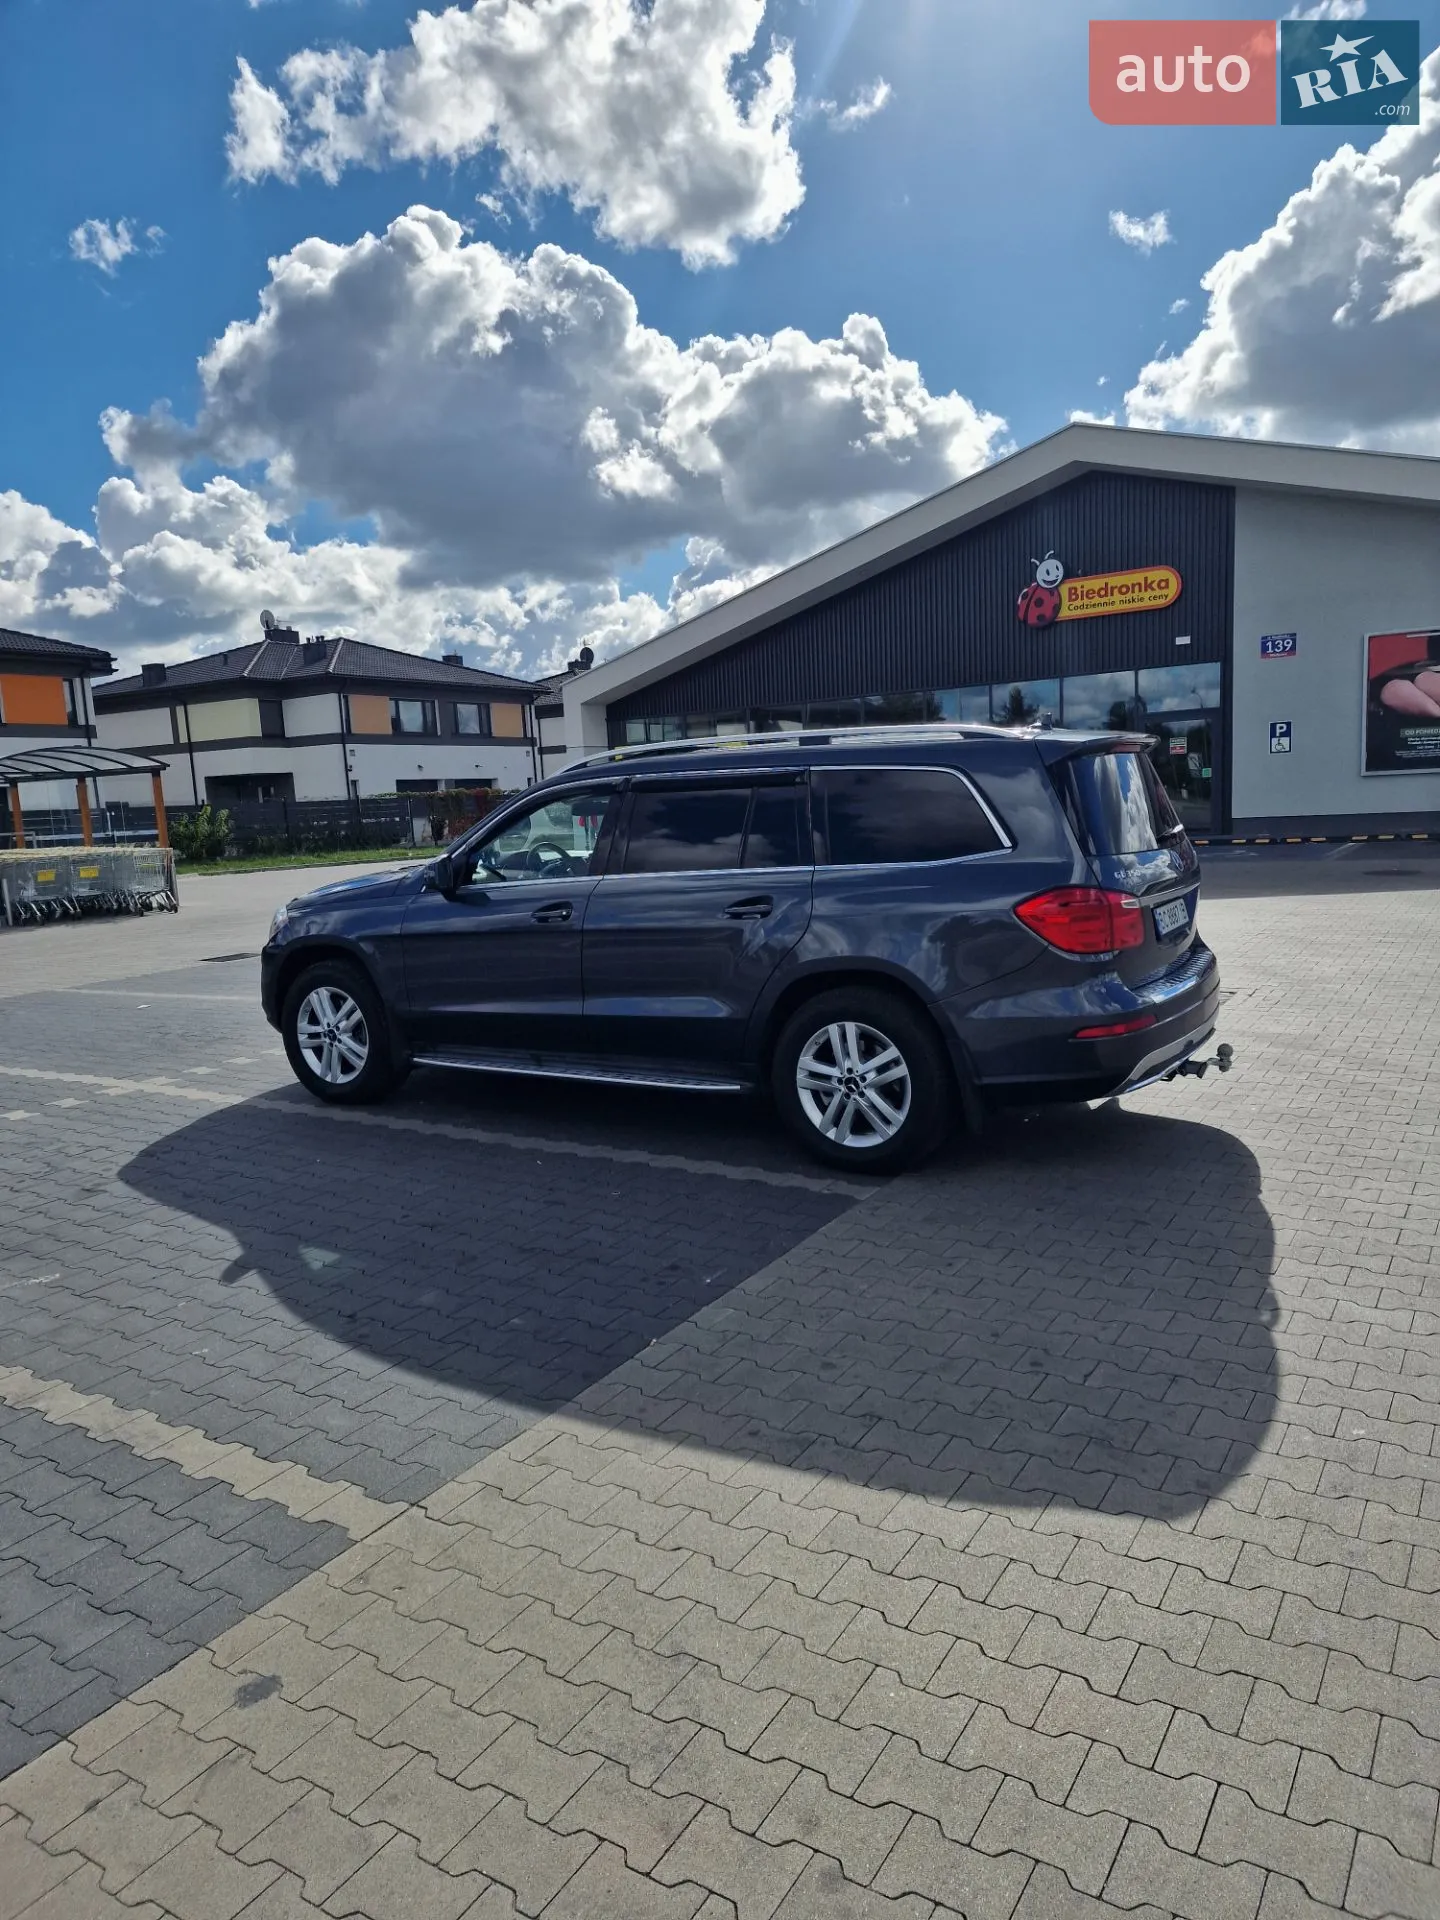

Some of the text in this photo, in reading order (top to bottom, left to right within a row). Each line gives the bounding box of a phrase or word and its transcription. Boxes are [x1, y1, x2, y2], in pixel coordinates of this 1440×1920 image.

[1067, 576, 1170, 603] Biedronka
[1067, 593, 1169, 612] Codziennie niskie ceny
[1266, 639, 1293, 653] 139
[1276, 723, 1287, 737] P
